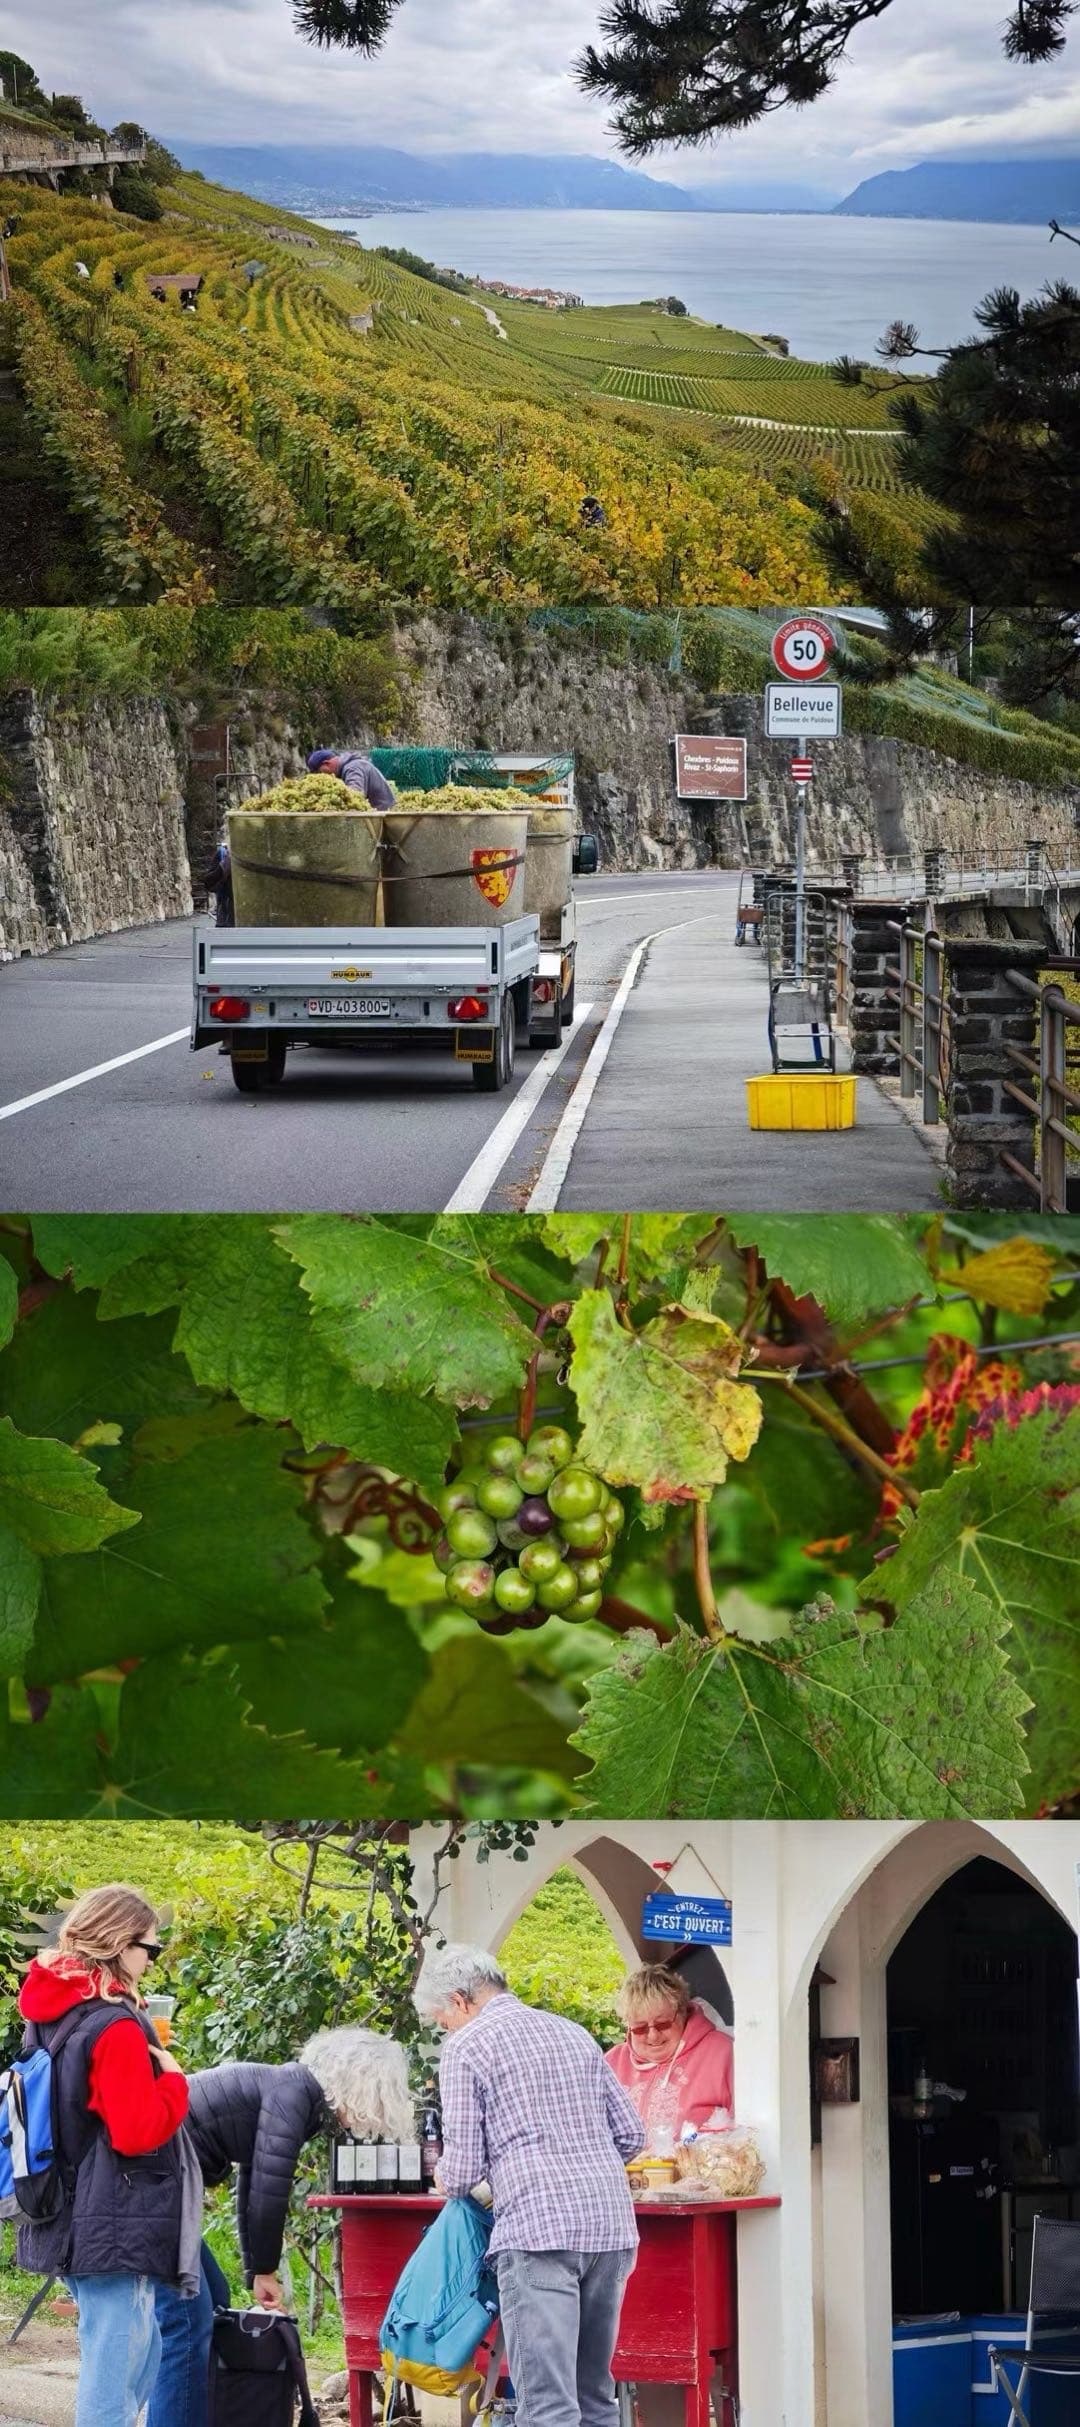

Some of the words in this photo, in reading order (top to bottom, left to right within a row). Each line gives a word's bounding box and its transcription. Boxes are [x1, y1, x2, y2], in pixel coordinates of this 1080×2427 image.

[793, 640, 817, 661] 50
[774, 697, 834, 712] Bellevue
[772, 715, 800, 723] Commune
[802, 715, 809, 723] de
[675, 1902, 704, 1915] ENTREZ
[654, 1914, 681, 1930] C'EST
[685, 1917, 725, 1934] OUVERT
